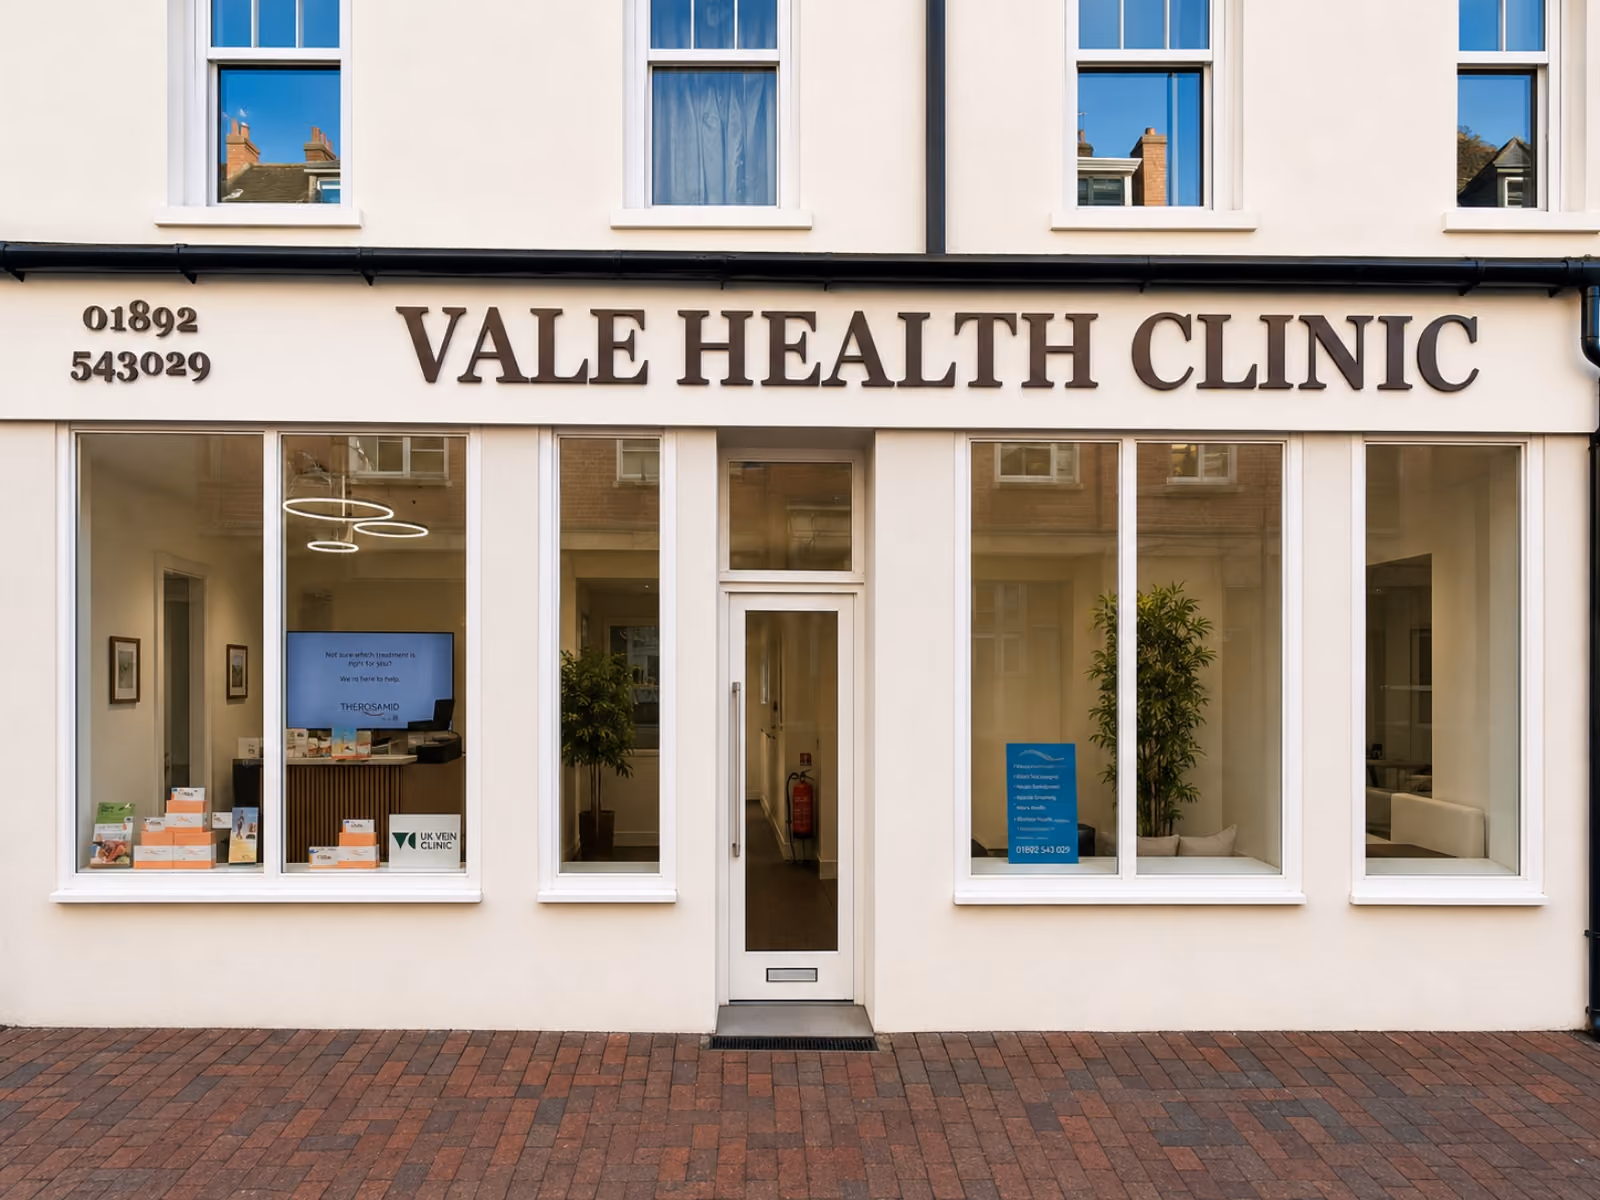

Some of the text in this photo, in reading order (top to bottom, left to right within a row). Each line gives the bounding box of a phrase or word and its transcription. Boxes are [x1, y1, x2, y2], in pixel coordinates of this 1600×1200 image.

[82, 299, 198, 337] 01892
[396, 306, 1480, 394] VALE HEALTH CLINIC
[70, 350, 211, 383] 543029
[325, 651, 338, 659] Not
[376, 651, 409, 659] treatment
[409, 651, 416, 659] is
[376, 660, 392, 669] you?
[420, 831, 457, 841] UK VEIN
[420, 841, 453, 850] CLINIC
